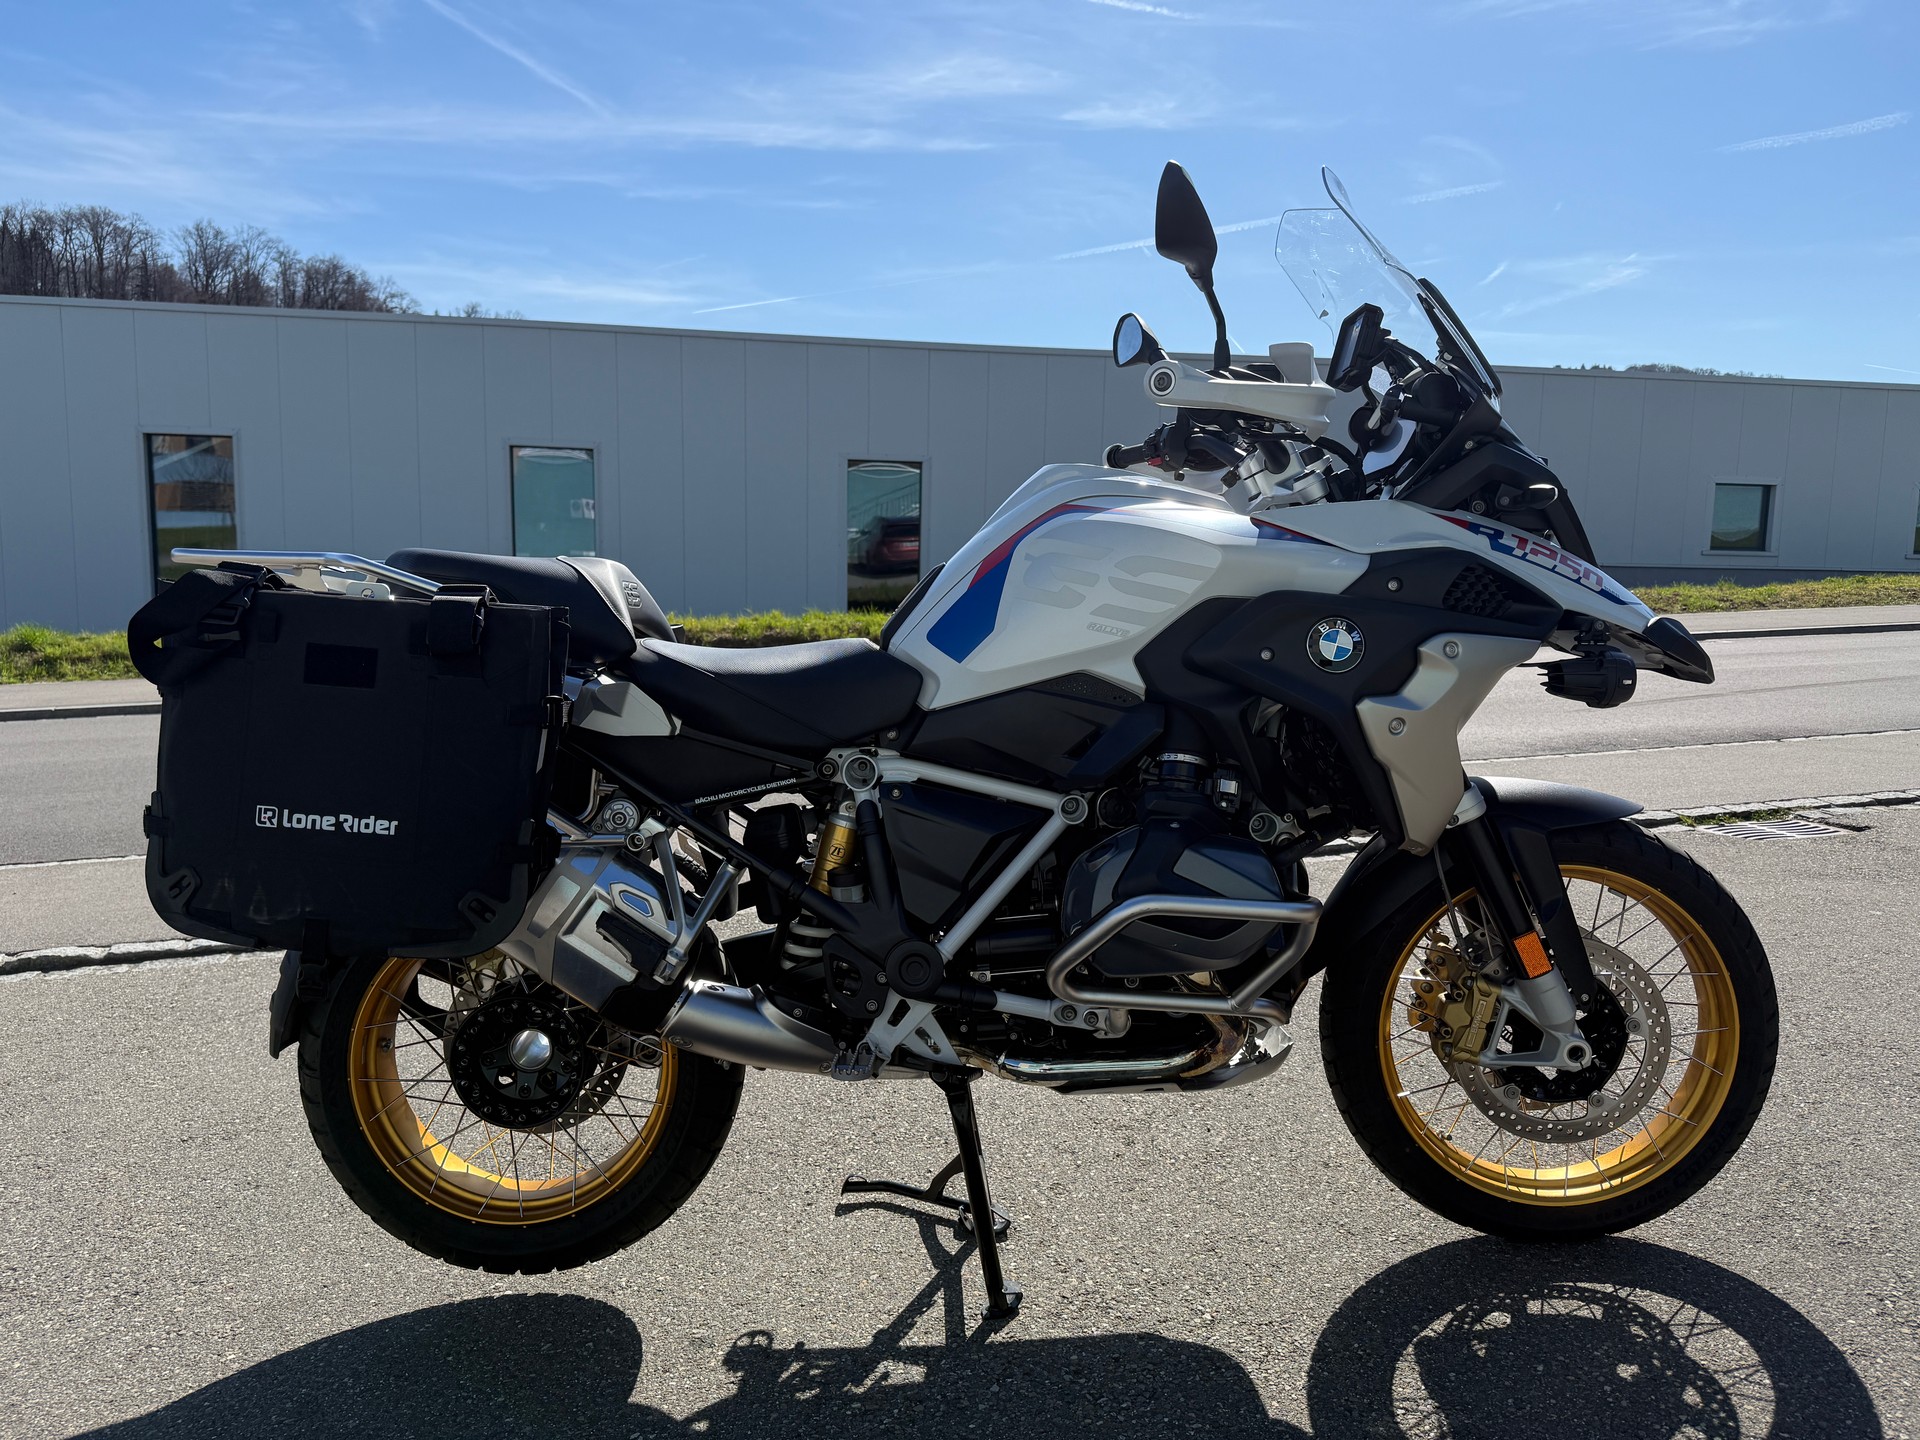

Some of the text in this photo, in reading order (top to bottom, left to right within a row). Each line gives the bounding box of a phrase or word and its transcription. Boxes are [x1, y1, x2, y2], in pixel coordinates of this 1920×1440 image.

[1318, 620, 1361, 642] BMW
[718, 784, 767, 800] MOTORCYCLES
[766, 777, 797, 789] DIETIKON
[282, 808, 337, 832] Lone
[338, 813, 399, 836] Rider
[1471, 1014, 1482, 1034] BMW
